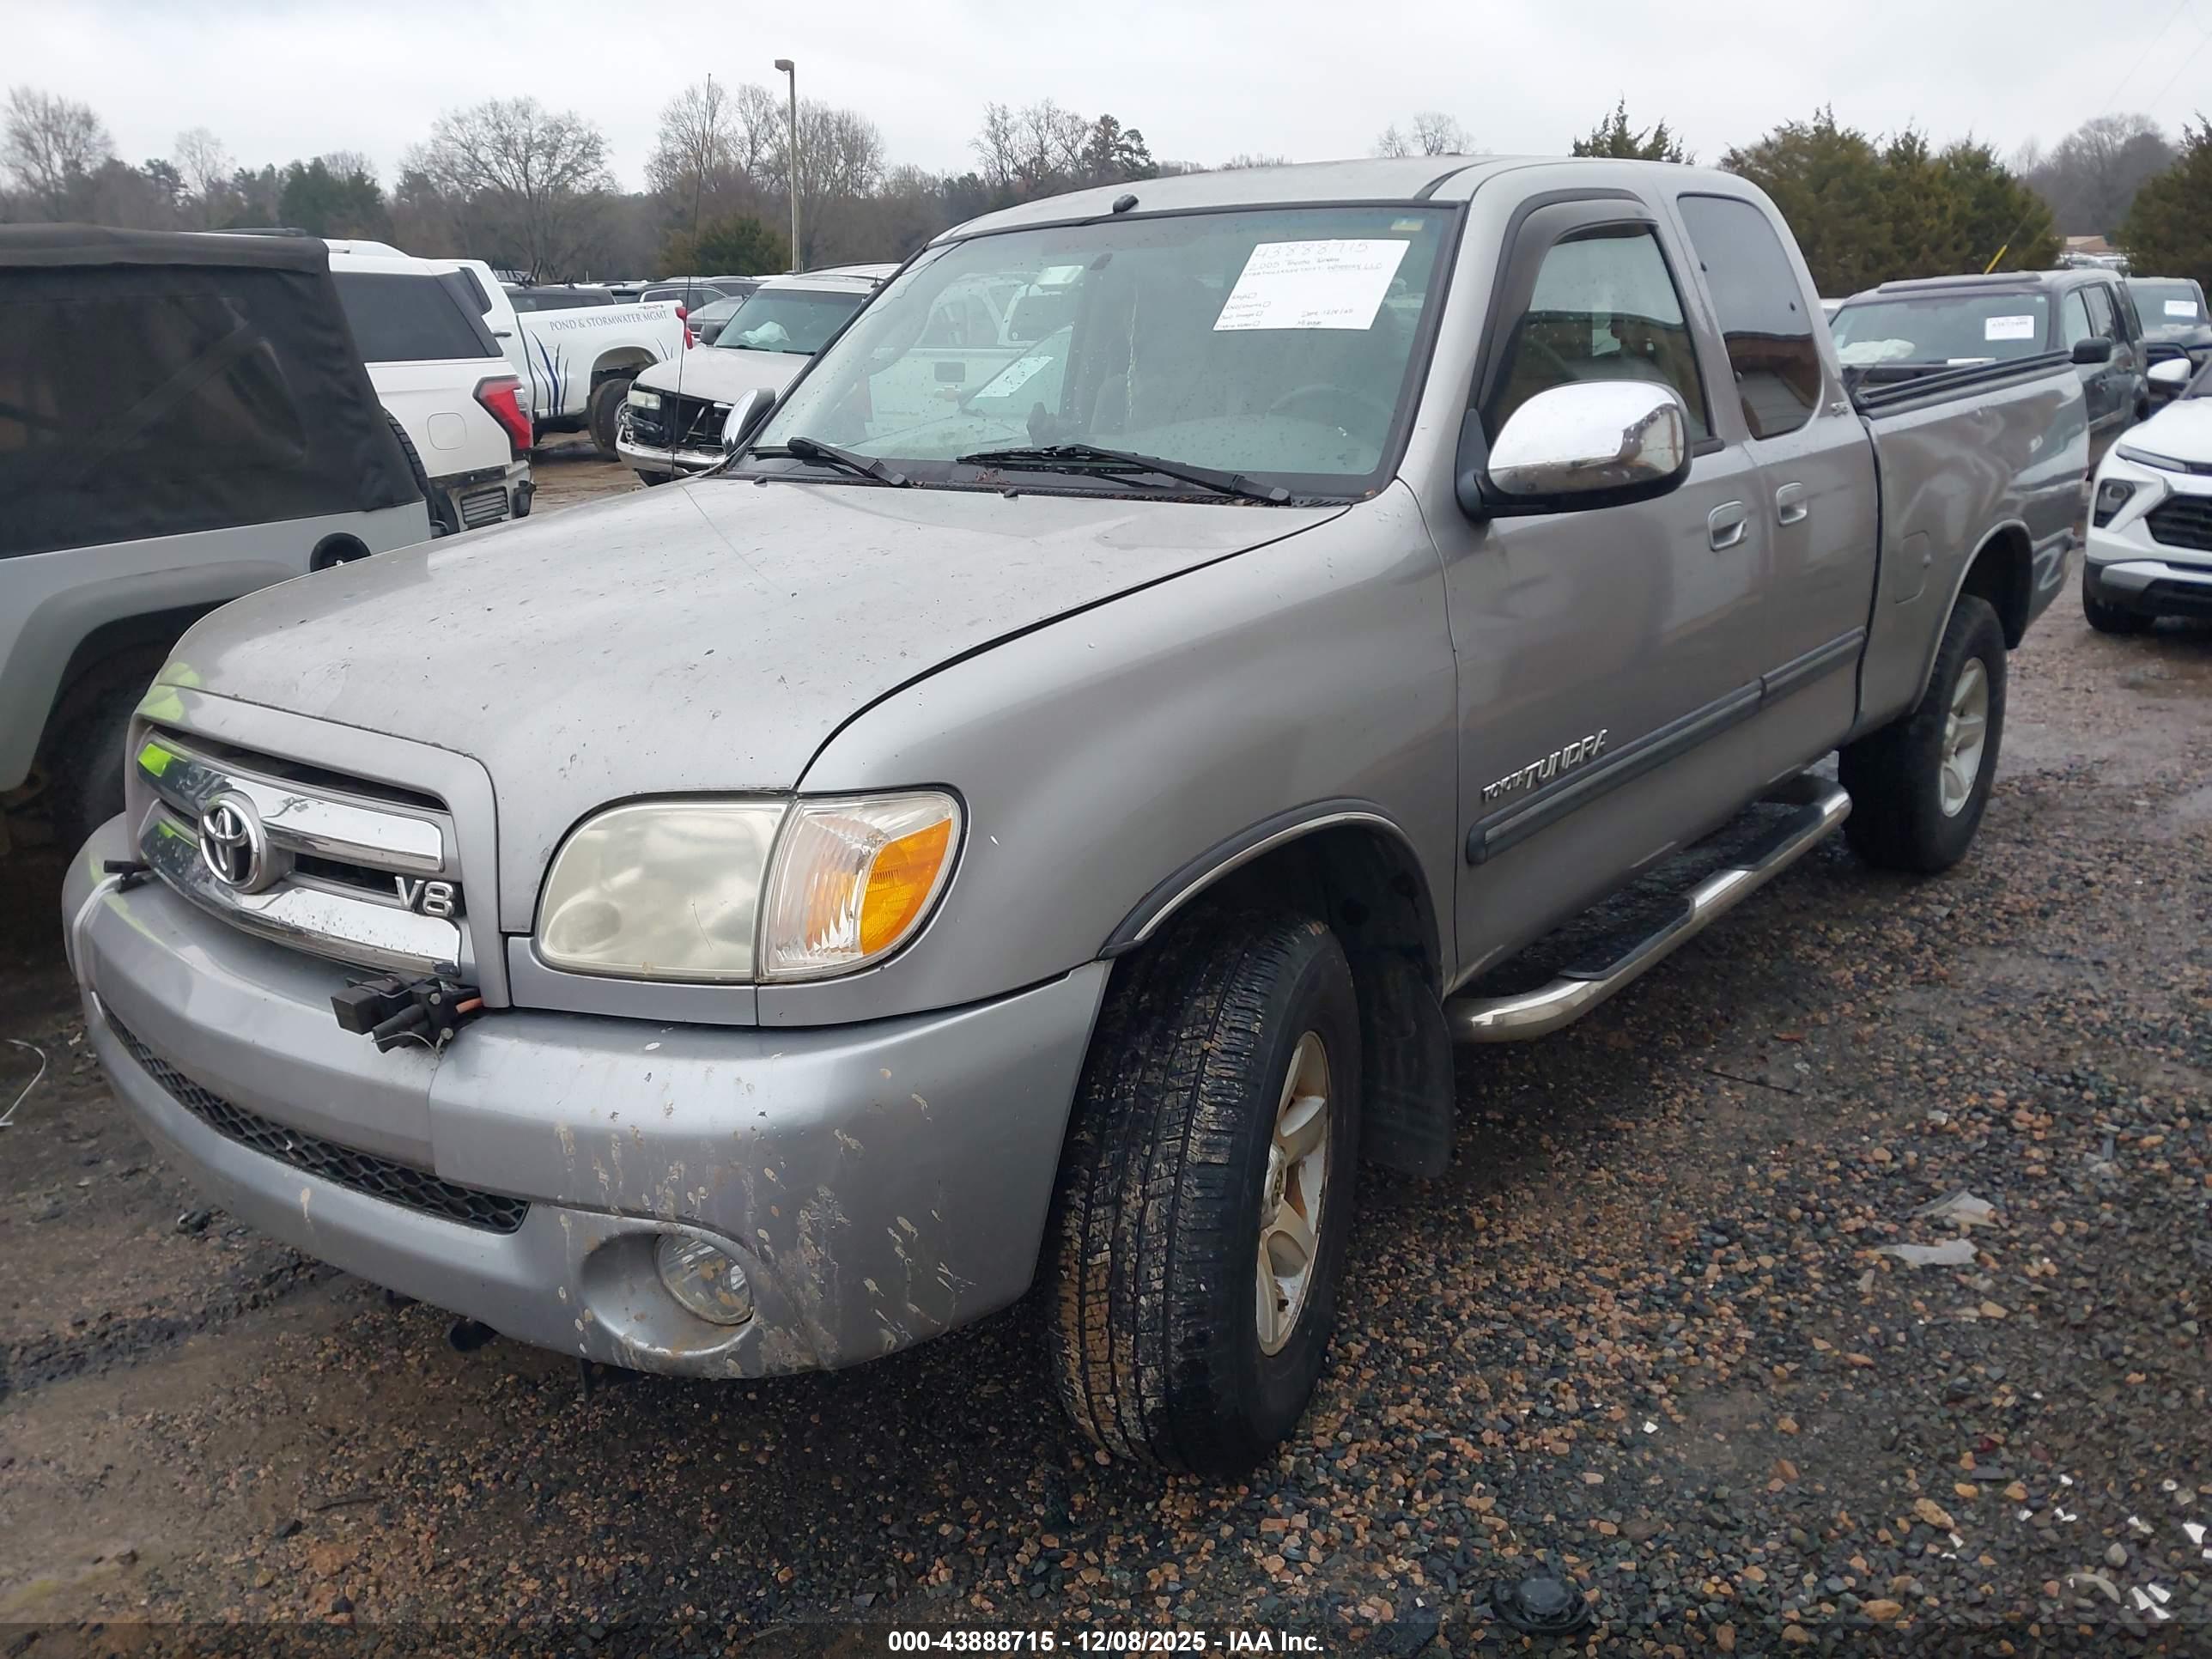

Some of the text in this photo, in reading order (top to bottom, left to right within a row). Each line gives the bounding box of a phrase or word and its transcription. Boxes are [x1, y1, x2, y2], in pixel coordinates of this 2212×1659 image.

[1255, 242, 1370, 258] 43888715
[549, 310, 667, 331] POND & STORMWATER MGMT
[394, 876, 455, 917] V8
